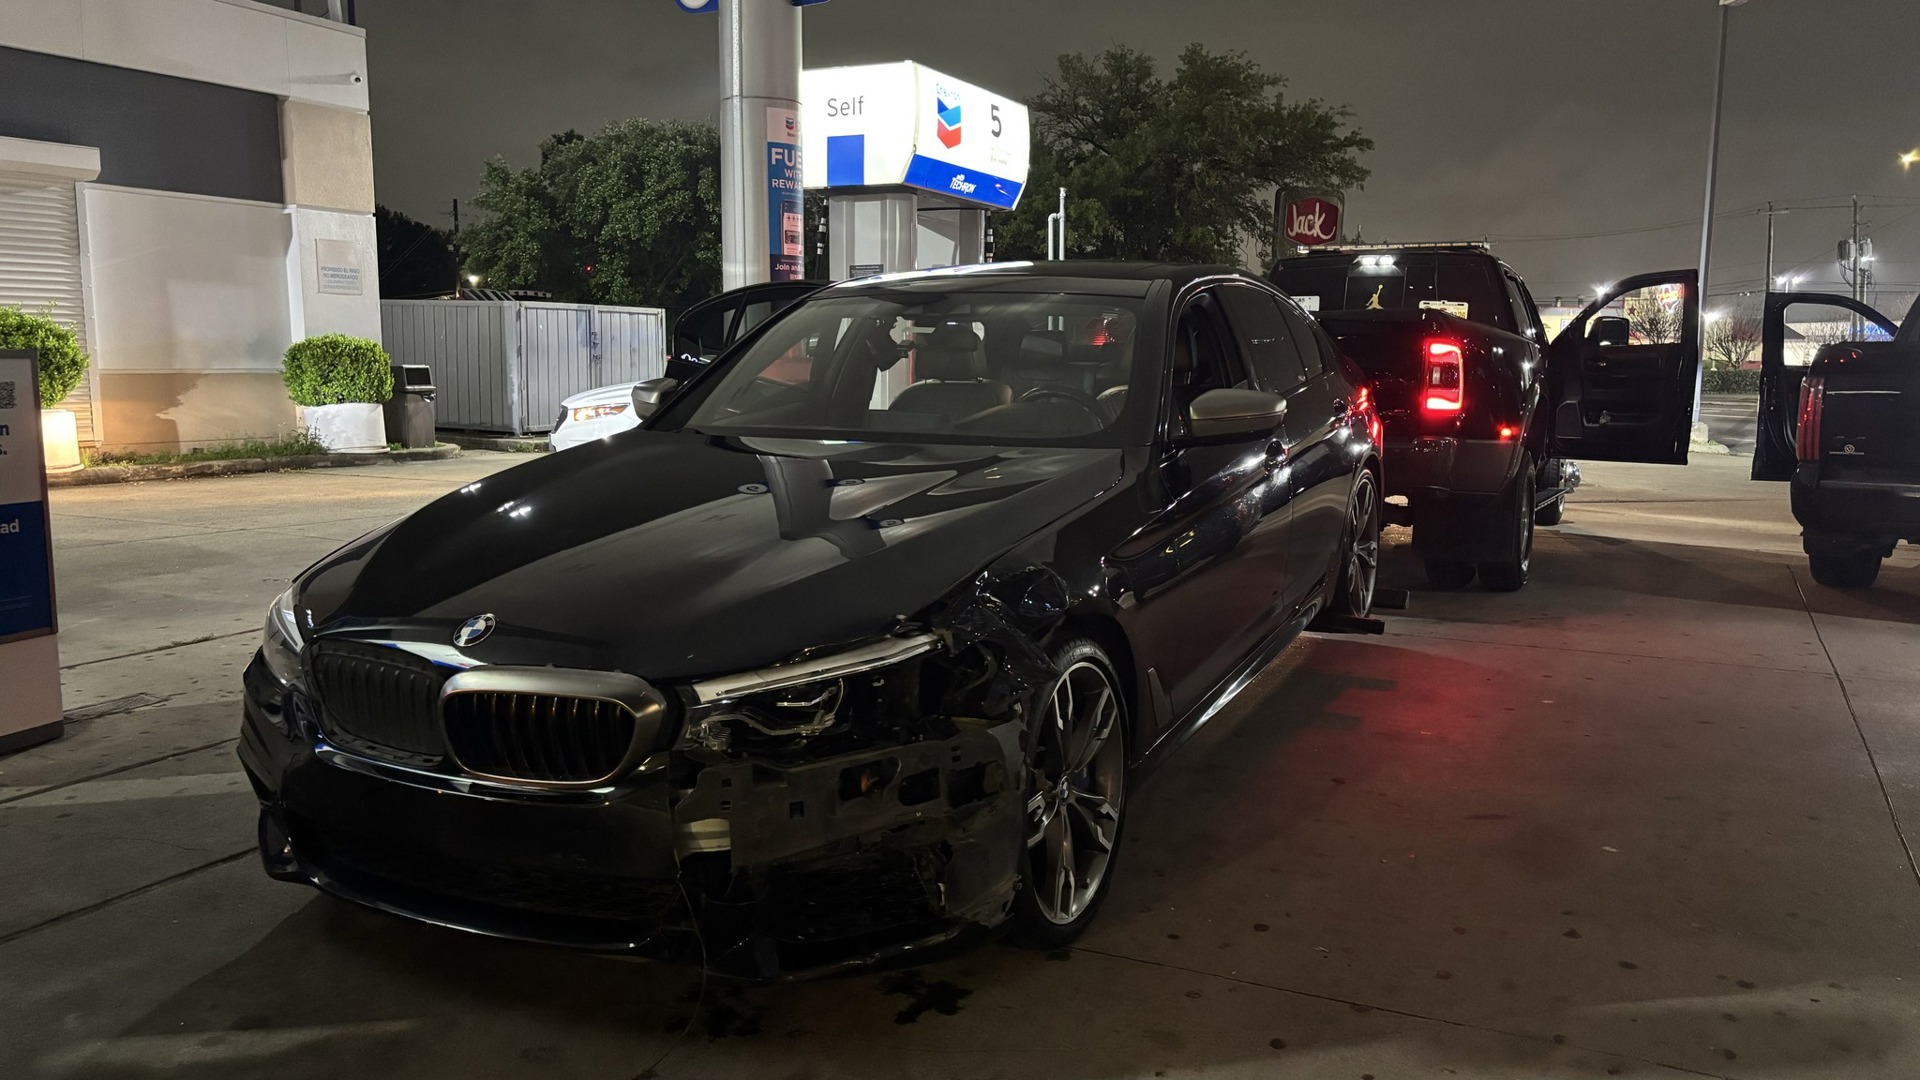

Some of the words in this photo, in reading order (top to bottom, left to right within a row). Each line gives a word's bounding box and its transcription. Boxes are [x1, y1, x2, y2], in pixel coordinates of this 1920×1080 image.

[827, 95, 864, 117] Self
[990, 103, 1002, 138] 5
[950, 177, 976, 193] TECHRON
[1287, 201, 1336, 240] Jack
[774, 263, 790, 271] Join
